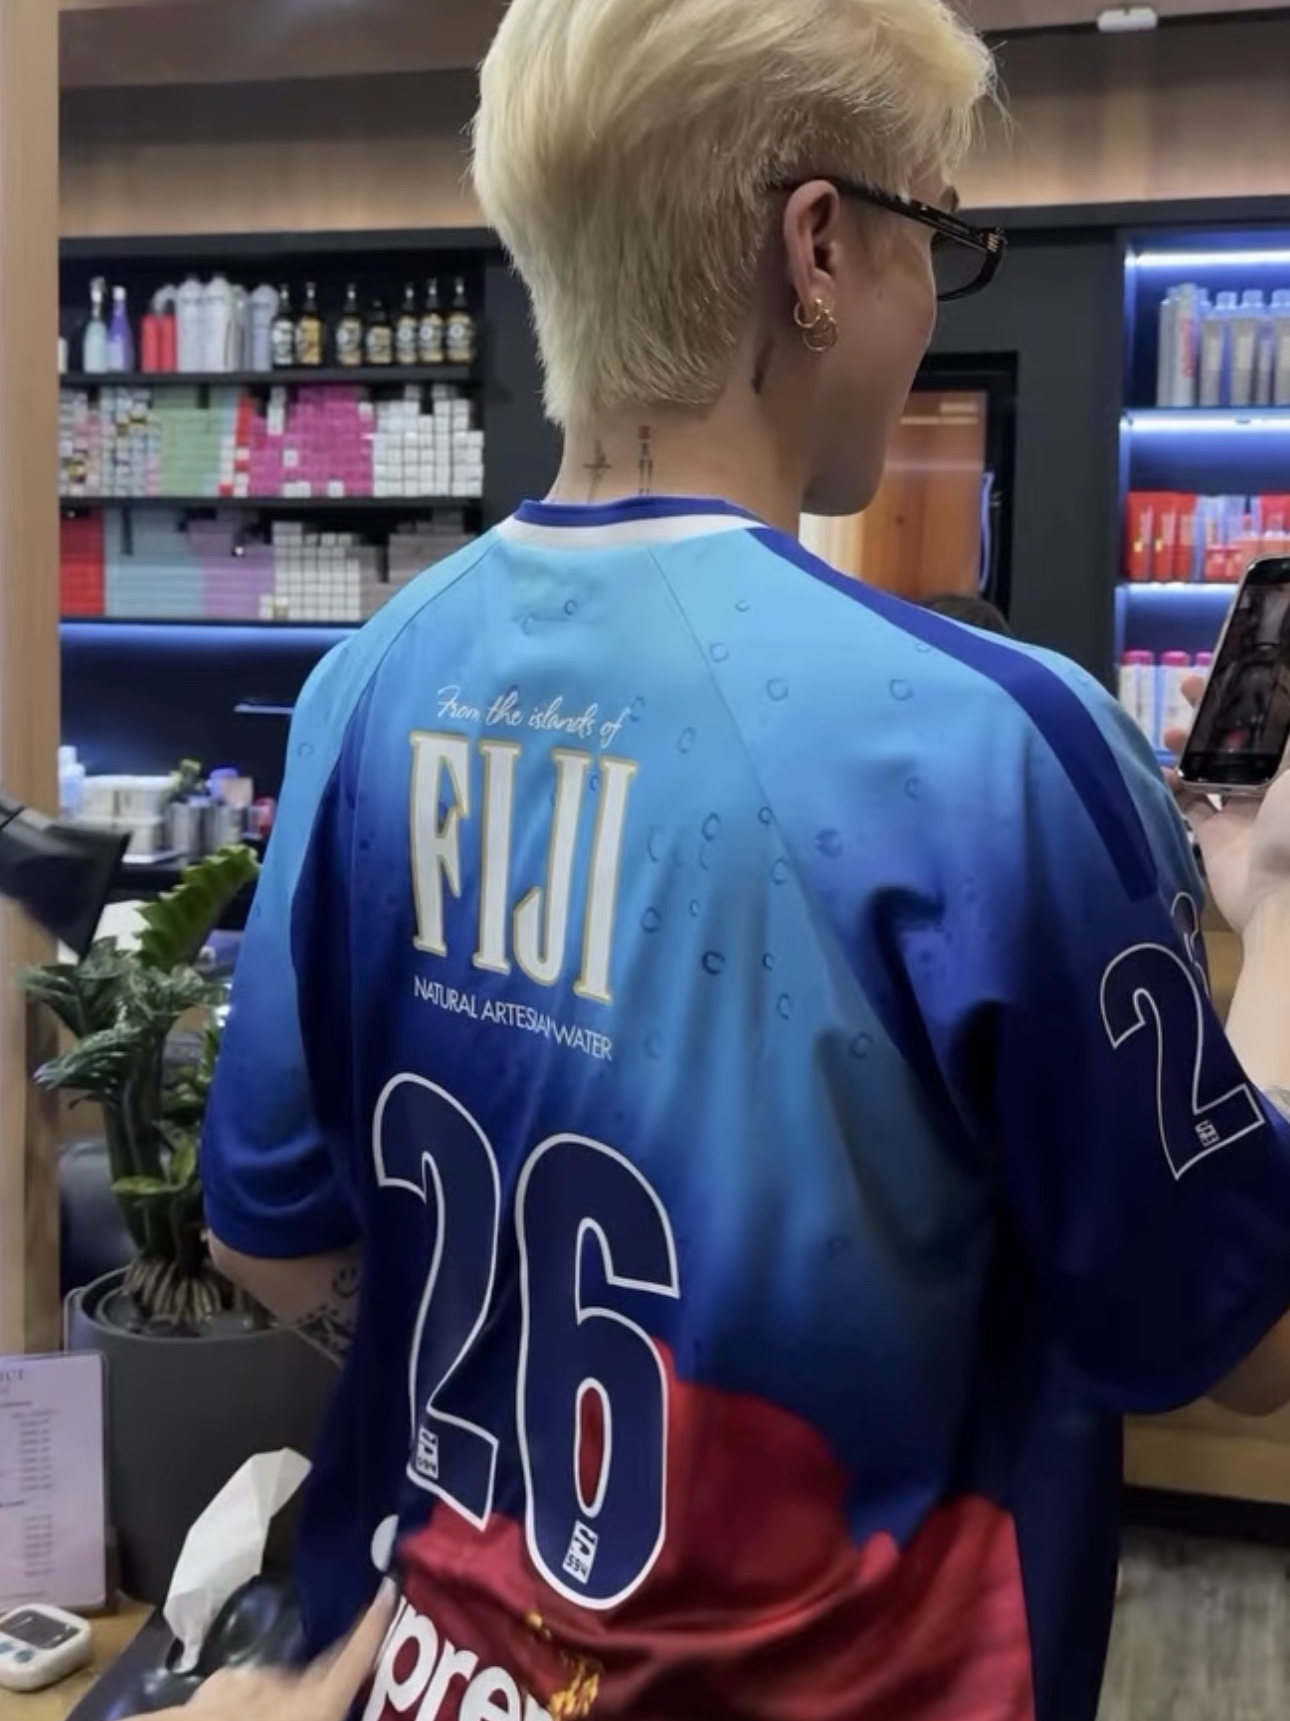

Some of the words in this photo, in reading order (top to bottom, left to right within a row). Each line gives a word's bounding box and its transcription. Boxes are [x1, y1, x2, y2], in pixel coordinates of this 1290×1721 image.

[437, 684, 480, 721] From
[485, 690, 523, 726] the
[528, 695, 599, 739] islands
[599, 705, 631, 749] of
[409, 730, 639, 1005] FIJI
[413, 974, 478, 1019] NATURAL
[552, 1021, 613, 1062] WATER
[372, 1072, 681, 1610] 26
[360, 1594, 554, 1721] pre
